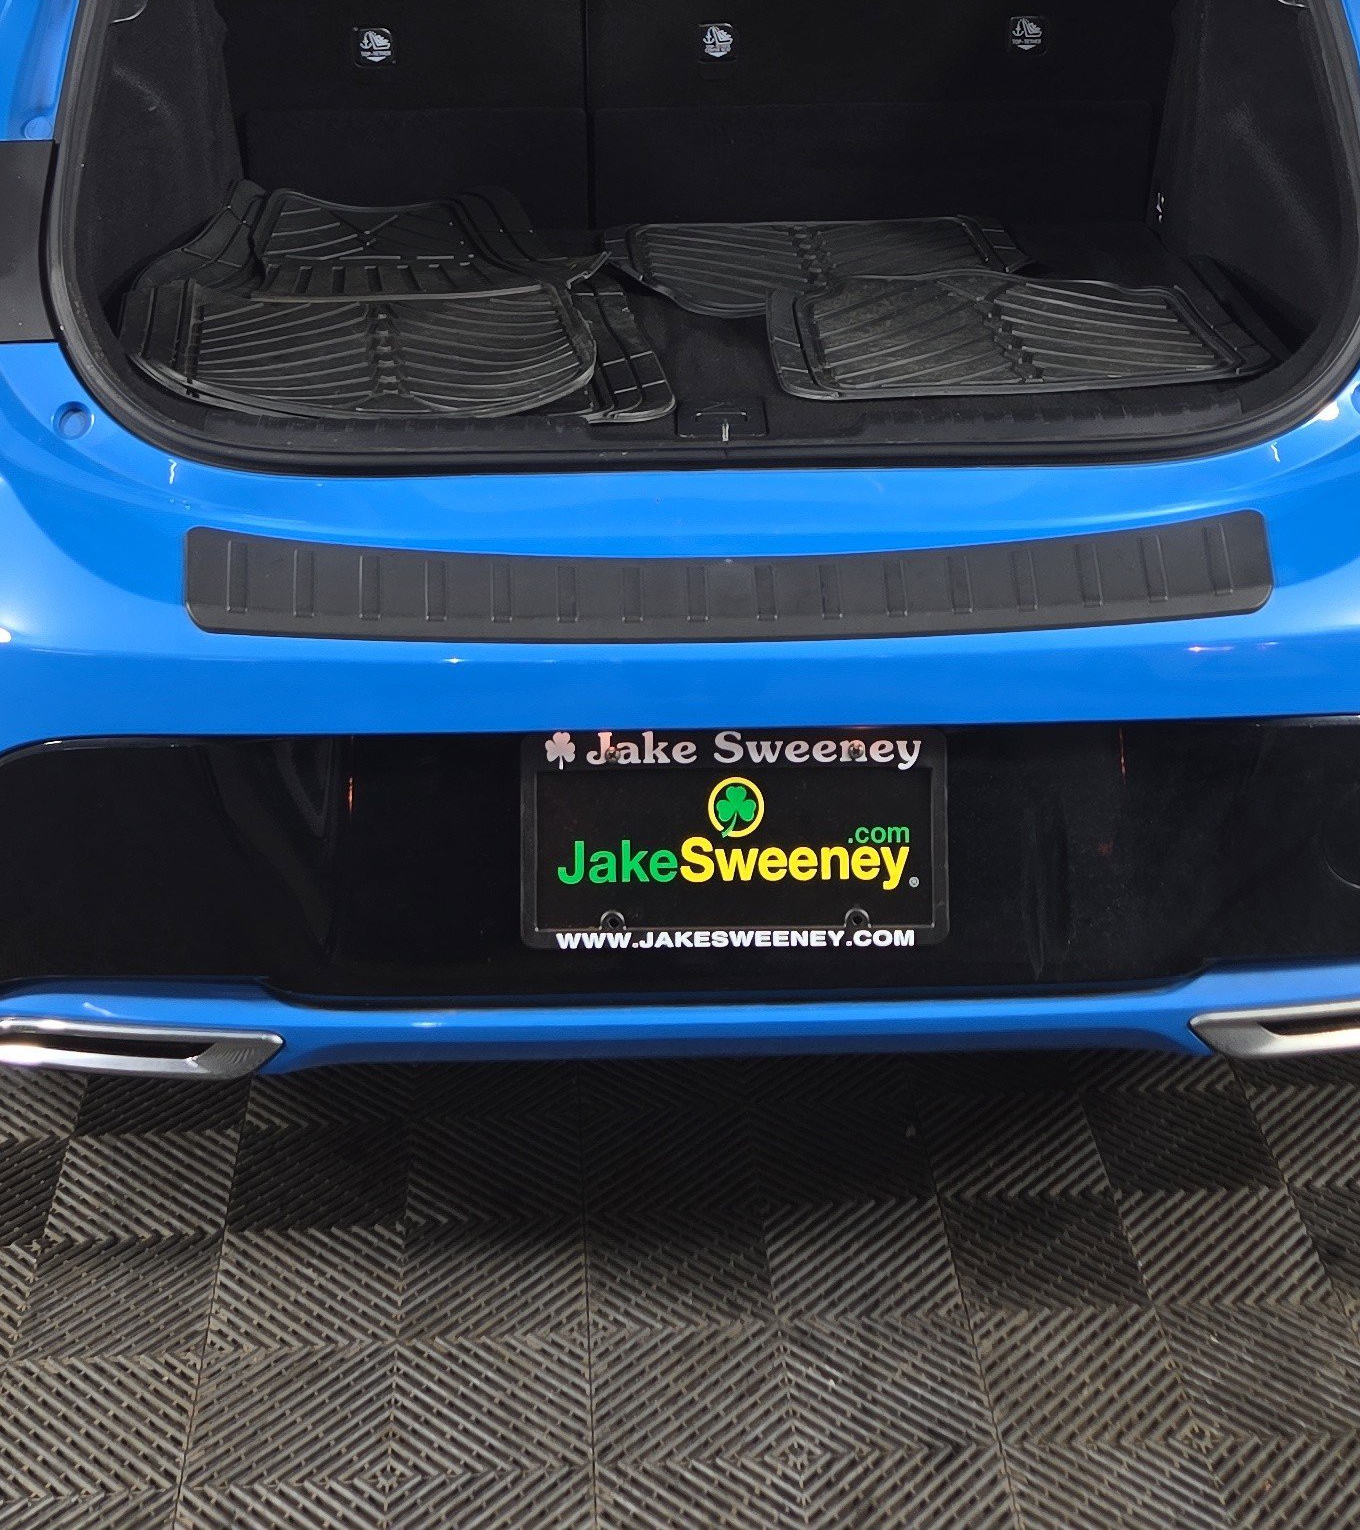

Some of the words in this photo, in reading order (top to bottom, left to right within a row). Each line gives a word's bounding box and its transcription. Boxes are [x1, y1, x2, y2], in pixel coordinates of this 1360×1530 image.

[586, 732, 698, 765] Jake
[713, 731, 922, 770] Sweeney
[555, 930, 916, 949] WWW.JAKESWEENEY.COM
